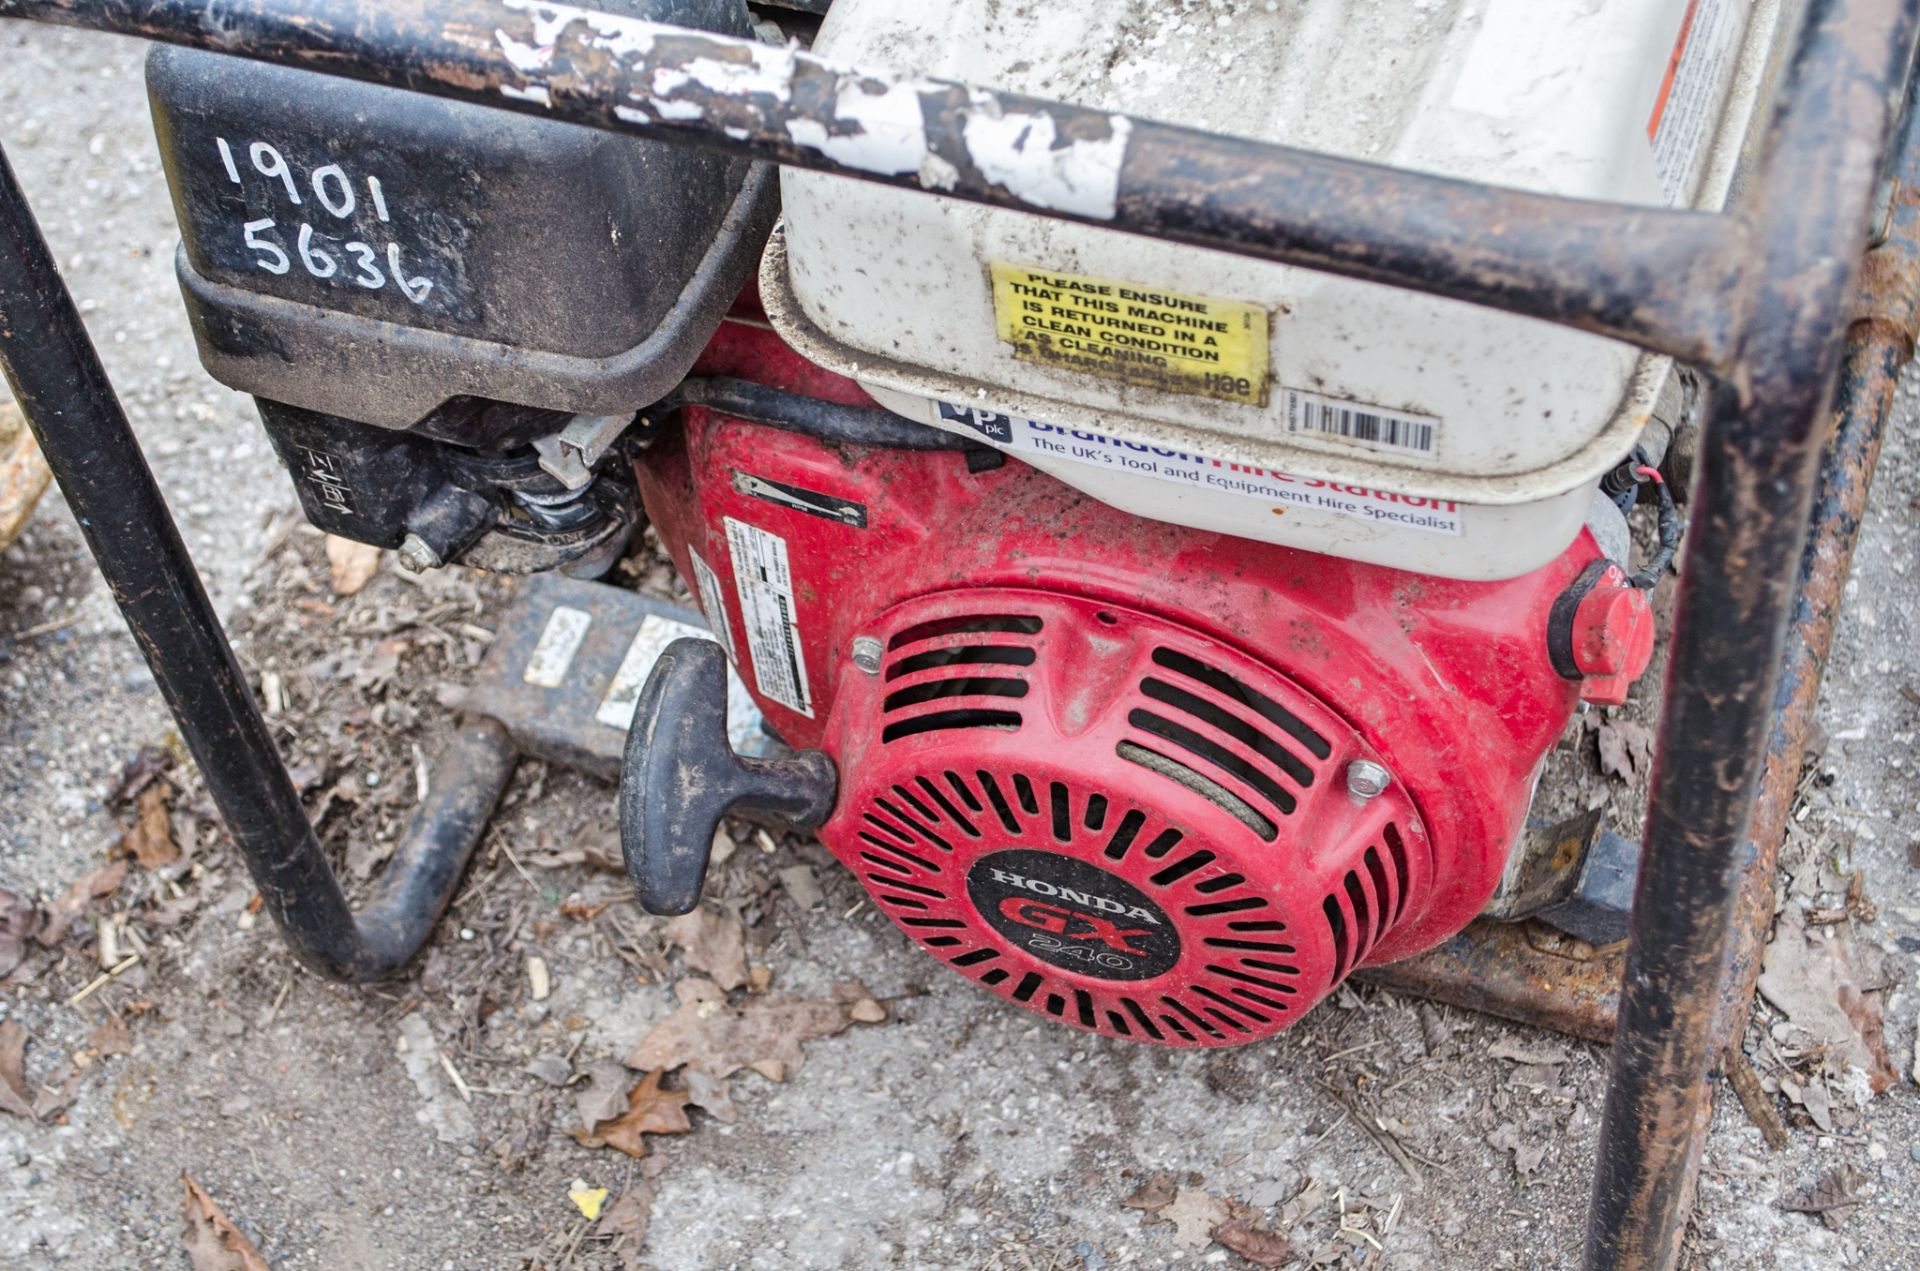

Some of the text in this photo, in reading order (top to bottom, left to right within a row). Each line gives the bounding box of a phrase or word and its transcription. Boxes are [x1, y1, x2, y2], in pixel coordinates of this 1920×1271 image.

[216, 137, 390, 222] 1901
[243, 218, 434, 305] 5636
[1010, 282, 1063, 301] THAT
[1070, 294, 1120, 313] THIS
[1127, 305, 1228, 333] MACHINE
[1027, 273, 1208, 314] PLEASE ENSURE
[1022, 300, 1218, 347] IS RETURNED IN A
[1022, 316, 1220, 362] CLEAN CONDITION
[1024, 331, 1168, 369] AS CLEANING
[1040, 346, 1168, 383] CHARGE
[985, 424, 1005, 435] plc
[1032, 437, 1066, 453] The
[1072, 446, 1112, 463] UK's
[1119, 456, 1158, 473] Tool
[1164, 466, 1199, 483] and
[1206, 473, 1311, 504] Equipment
[1318, 495, 1357, 514] Hire
[1363, 505, 1456, 531] Specialist
[990, 867, 1161, 926] HONDA
[999, 897, 1152, 957] GX
[1028, 933, 1133, 971] 240
